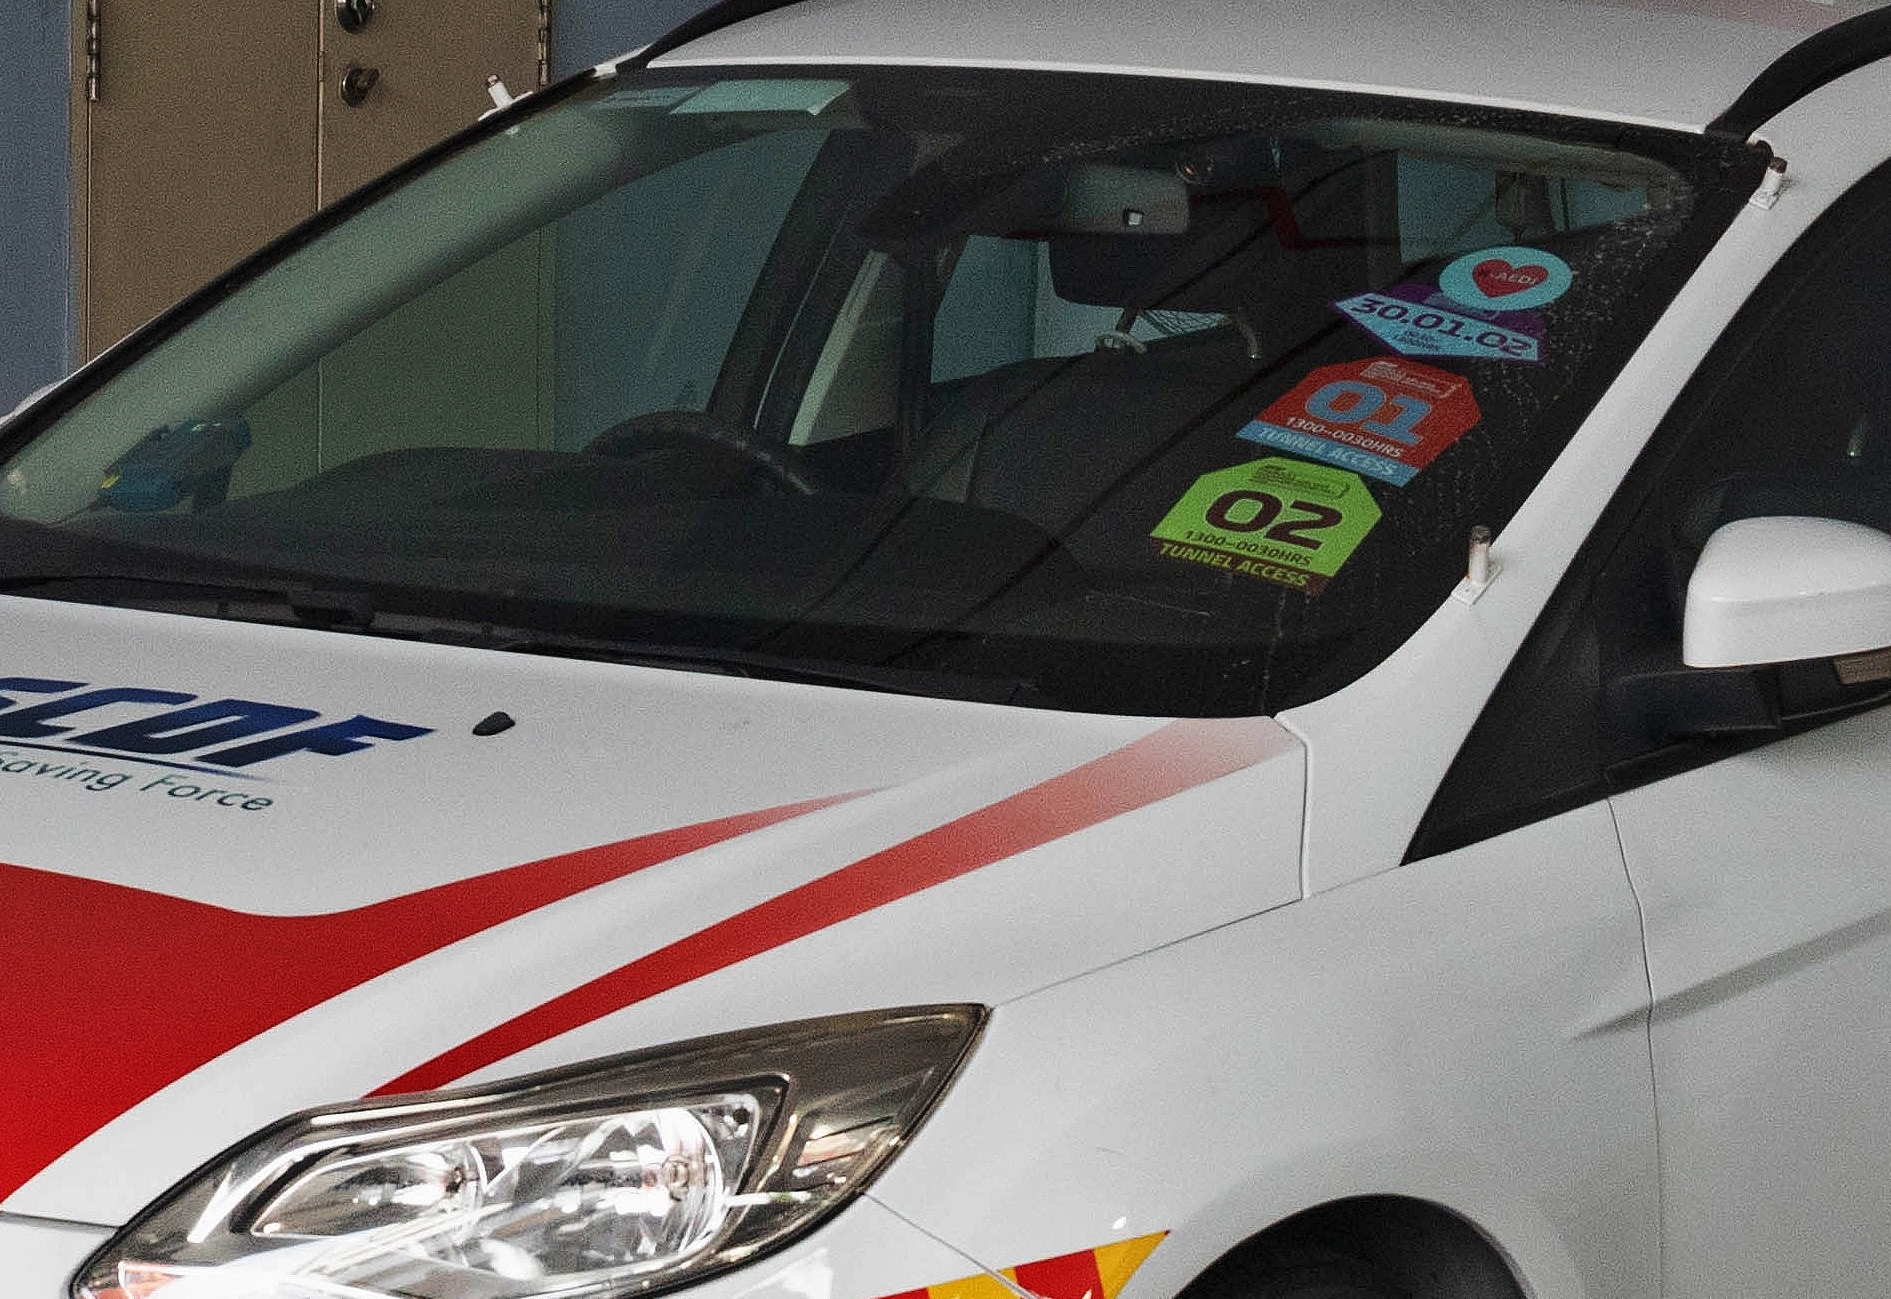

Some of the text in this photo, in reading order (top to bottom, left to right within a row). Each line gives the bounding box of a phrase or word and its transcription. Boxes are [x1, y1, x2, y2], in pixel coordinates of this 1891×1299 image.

[1350, 297, 1533, 359] 30.01.02
[1304, 379, 1433, 445] 01
[1259, 426, 1398, 476] TUNNEL ACCESS
[1205, 489, 1343, 550] 02
[1160, 543, 1311, 588] TUNNEL ACCESS
[139, 773, 275, 812] Force
